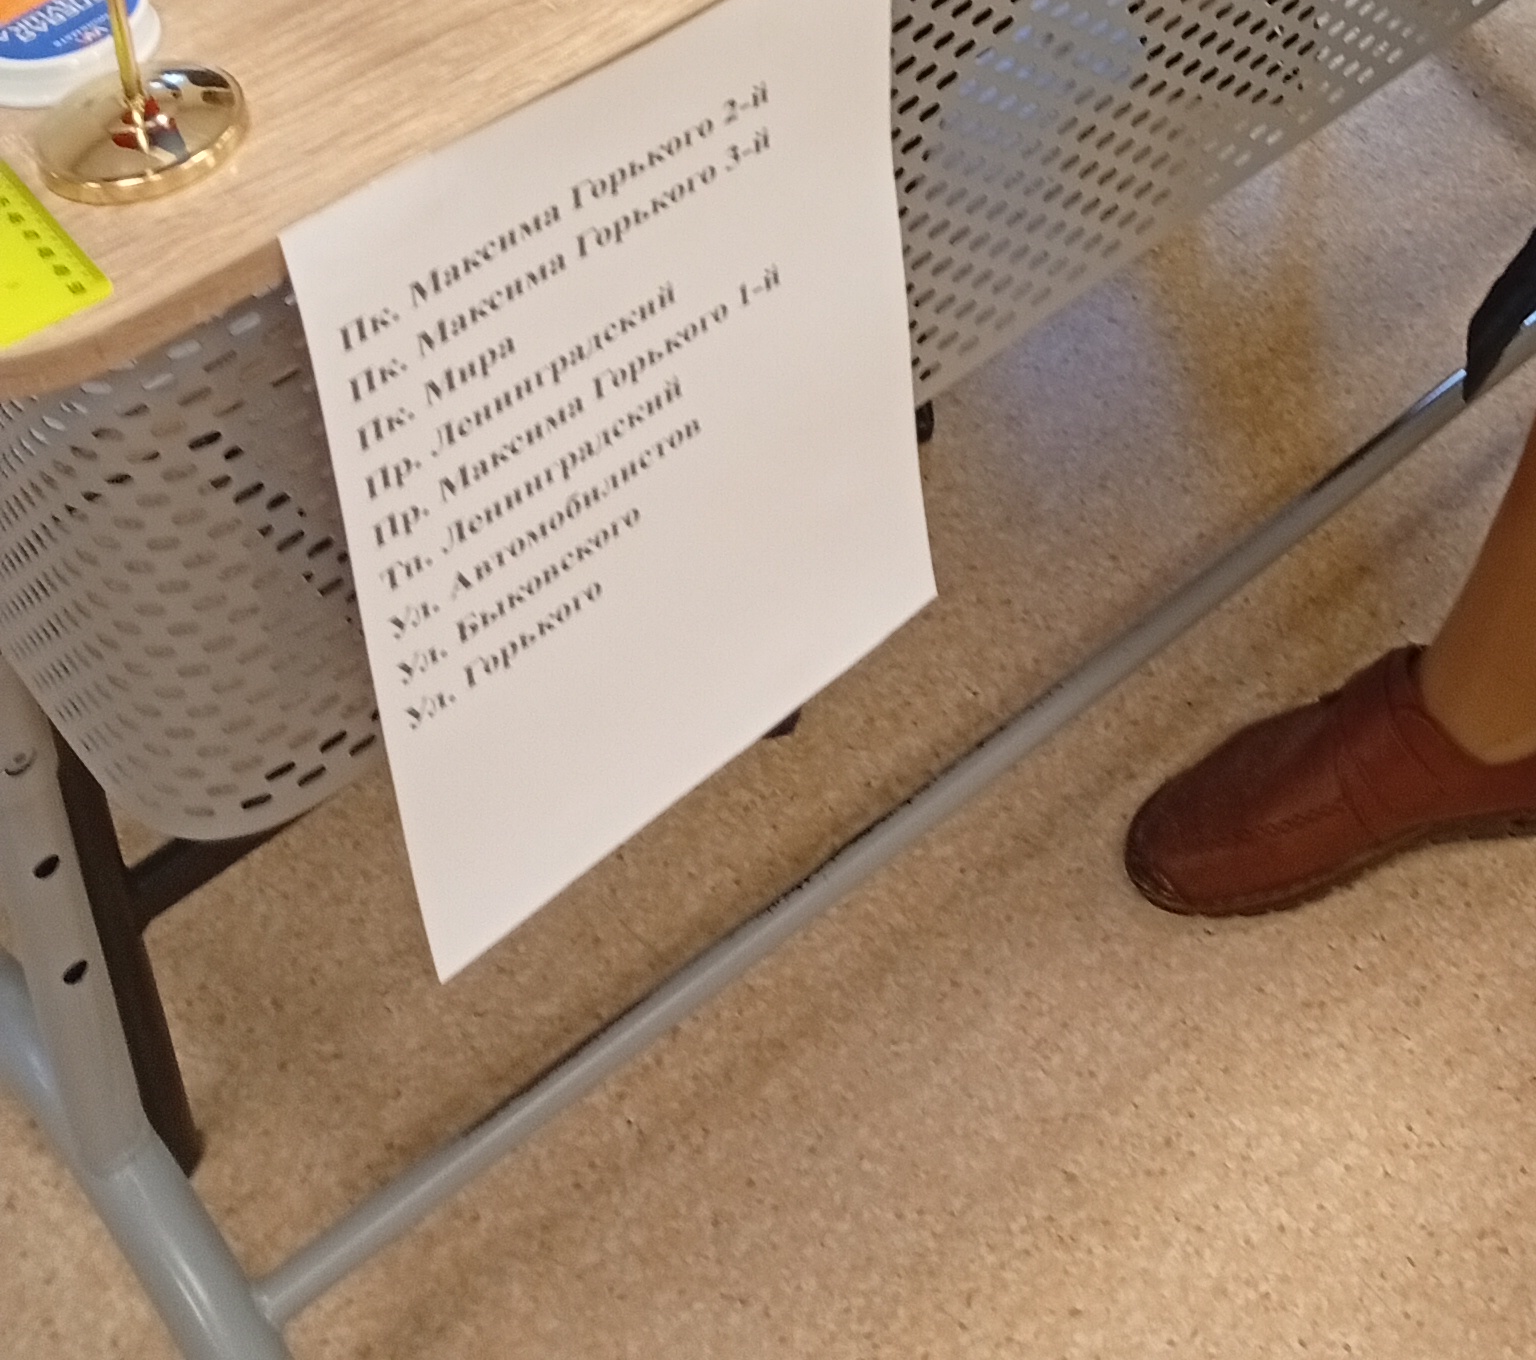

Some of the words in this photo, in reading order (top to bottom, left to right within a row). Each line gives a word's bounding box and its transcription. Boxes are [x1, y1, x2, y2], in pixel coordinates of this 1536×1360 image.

[339, 306, 401, 353] Пк.
[409, 204, 561, 309] Максима
[570, 118, 715, 210] Горького
[723, 80, 769, 126] 2-й
[349, 357, 409, 403] Пк.
[417, 253, 567, 359] Максима
[576, 164, 718, 259] Горького
[724, 126, 771, 173] 3-й
[357, 406, 416, 452] Пк.
[424, 336, 517, 407] Мира
[365, 456, 423, 500] Пр.
[430, 280, 677, 458] Ленинградский
[372, 504, 431, 549] Пр.
[439, 396, 585, 504] Максима
[593, 302, 729, 400] Горького
[738, 262, 781, 307] 1-й
[440, 373, 683, 556] Ленинградский
[388, 600, 441, 641] Ул.
[451, 418, 702, 602] Автомобилистов
[397, 646, 449, 686] Ул.
[456, 507, 642, 644] Быковского
[405, 691, 457, 731] Ул.
[464, 581, 602, 688] Горького
